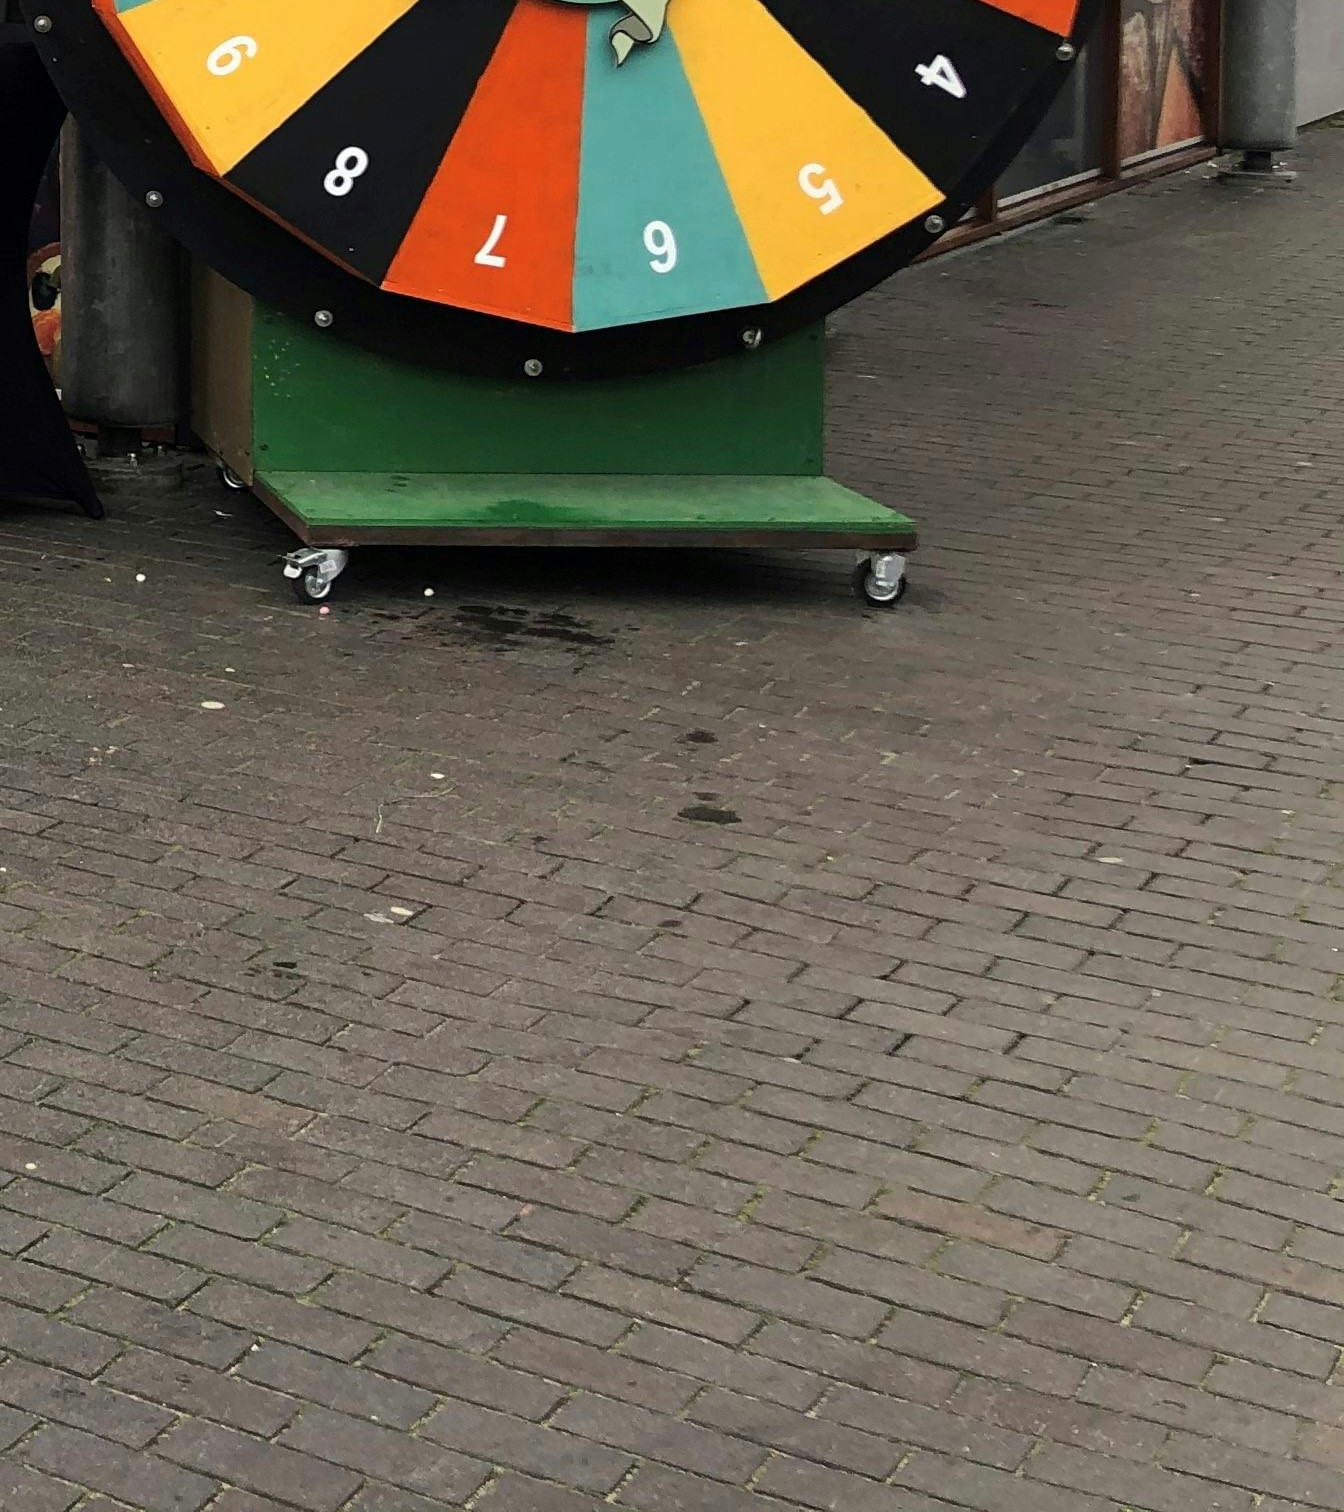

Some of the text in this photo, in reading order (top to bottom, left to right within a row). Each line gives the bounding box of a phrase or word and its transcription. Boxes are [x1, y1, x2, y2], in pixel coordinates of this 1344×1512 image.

[914, 54, 967, 99] 4
[324, 146, 369, 196] 8
[798, 162, 844, 215] 5
[474, 214, 506, 268] 7
